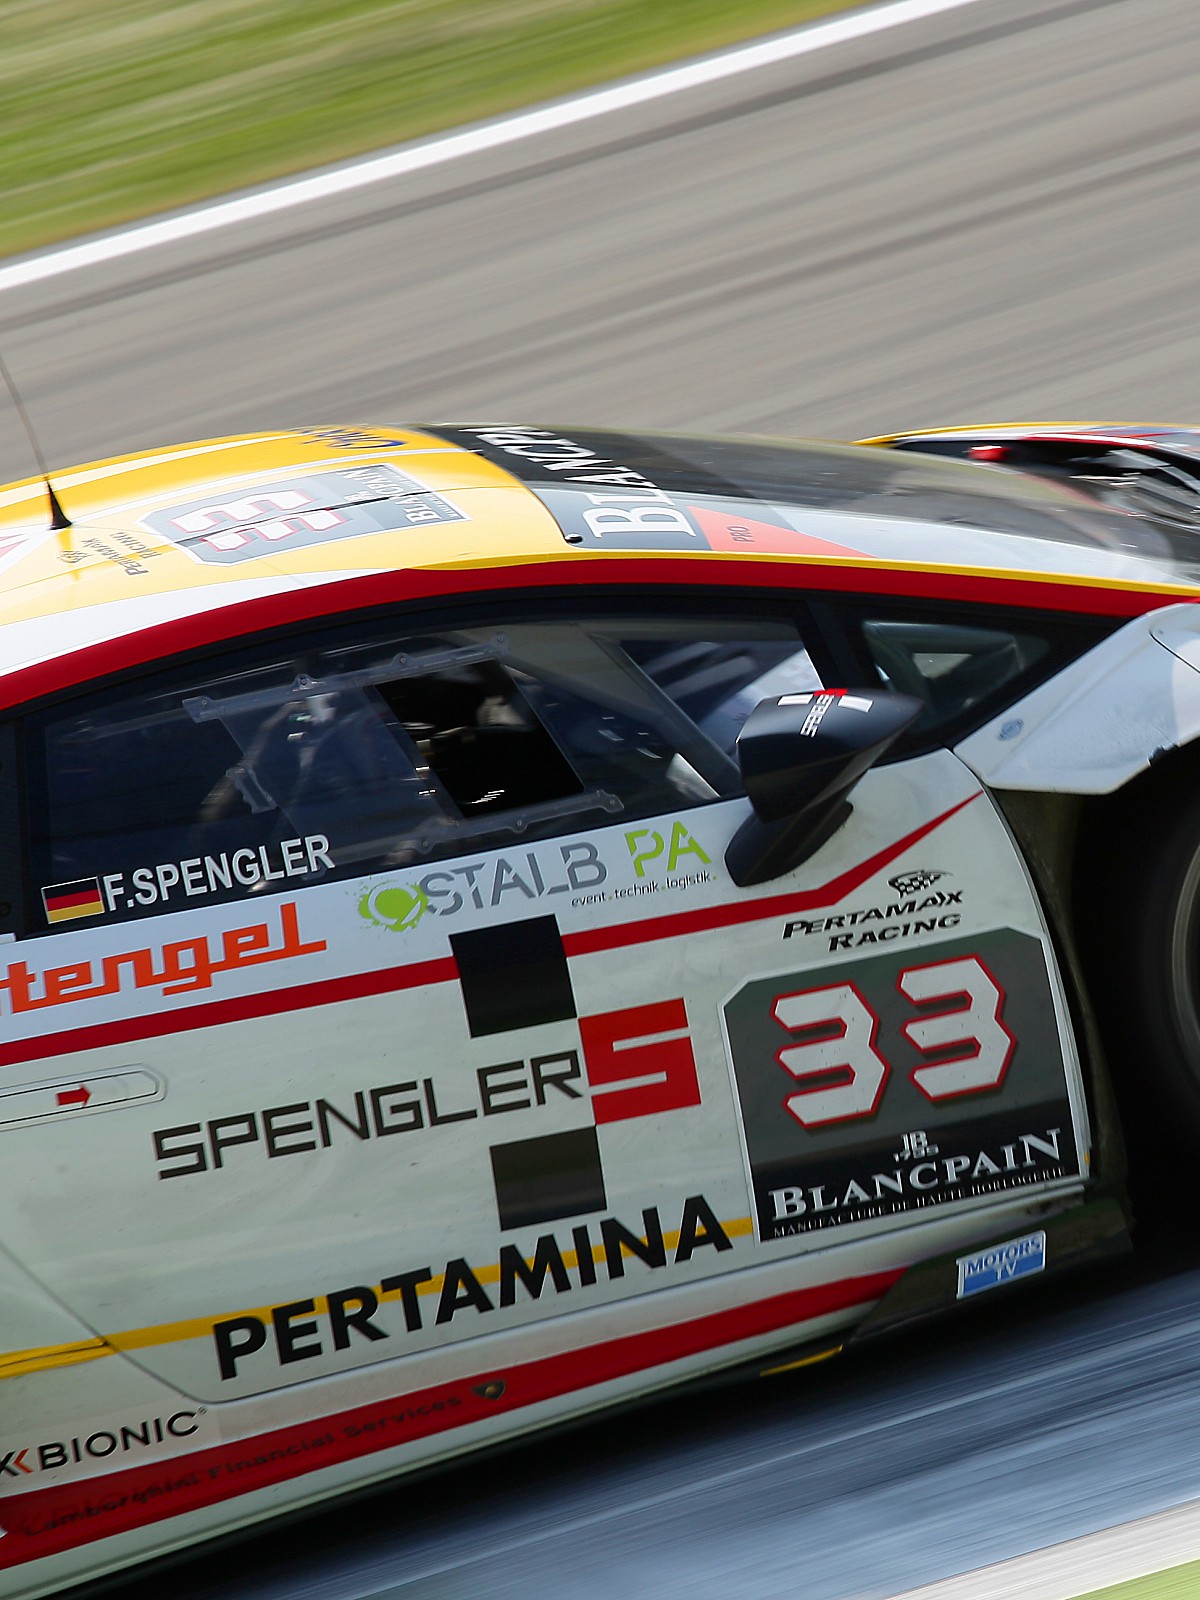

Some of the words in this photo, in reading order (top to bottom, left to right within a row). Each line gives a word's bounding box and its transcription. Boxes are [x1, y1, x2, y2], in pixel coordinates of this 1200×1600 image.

[726, 525, 756, 544] PRO
[103, 834, 336, 911] F.SPENGLER
[624, 820, 713, 878] PA
[0, 902, 327, 1015] tengel
[828, 913, 962, 953] RACING
[772, 954, 1016, 1126] 33
[767, 1127, 1062, 1222] BLANCPAIN
[773, 1206, 885, 1239] MANUFACTURE
[212, 1194, 733, 1381] PERTAMINA
[965, 1236, 1041, 1277] MOTORS
[994, 1258, 1018, 1281] TV
[208, 1432, 335, 1480] Financial
[344, 1395, 462, 1438] Services
